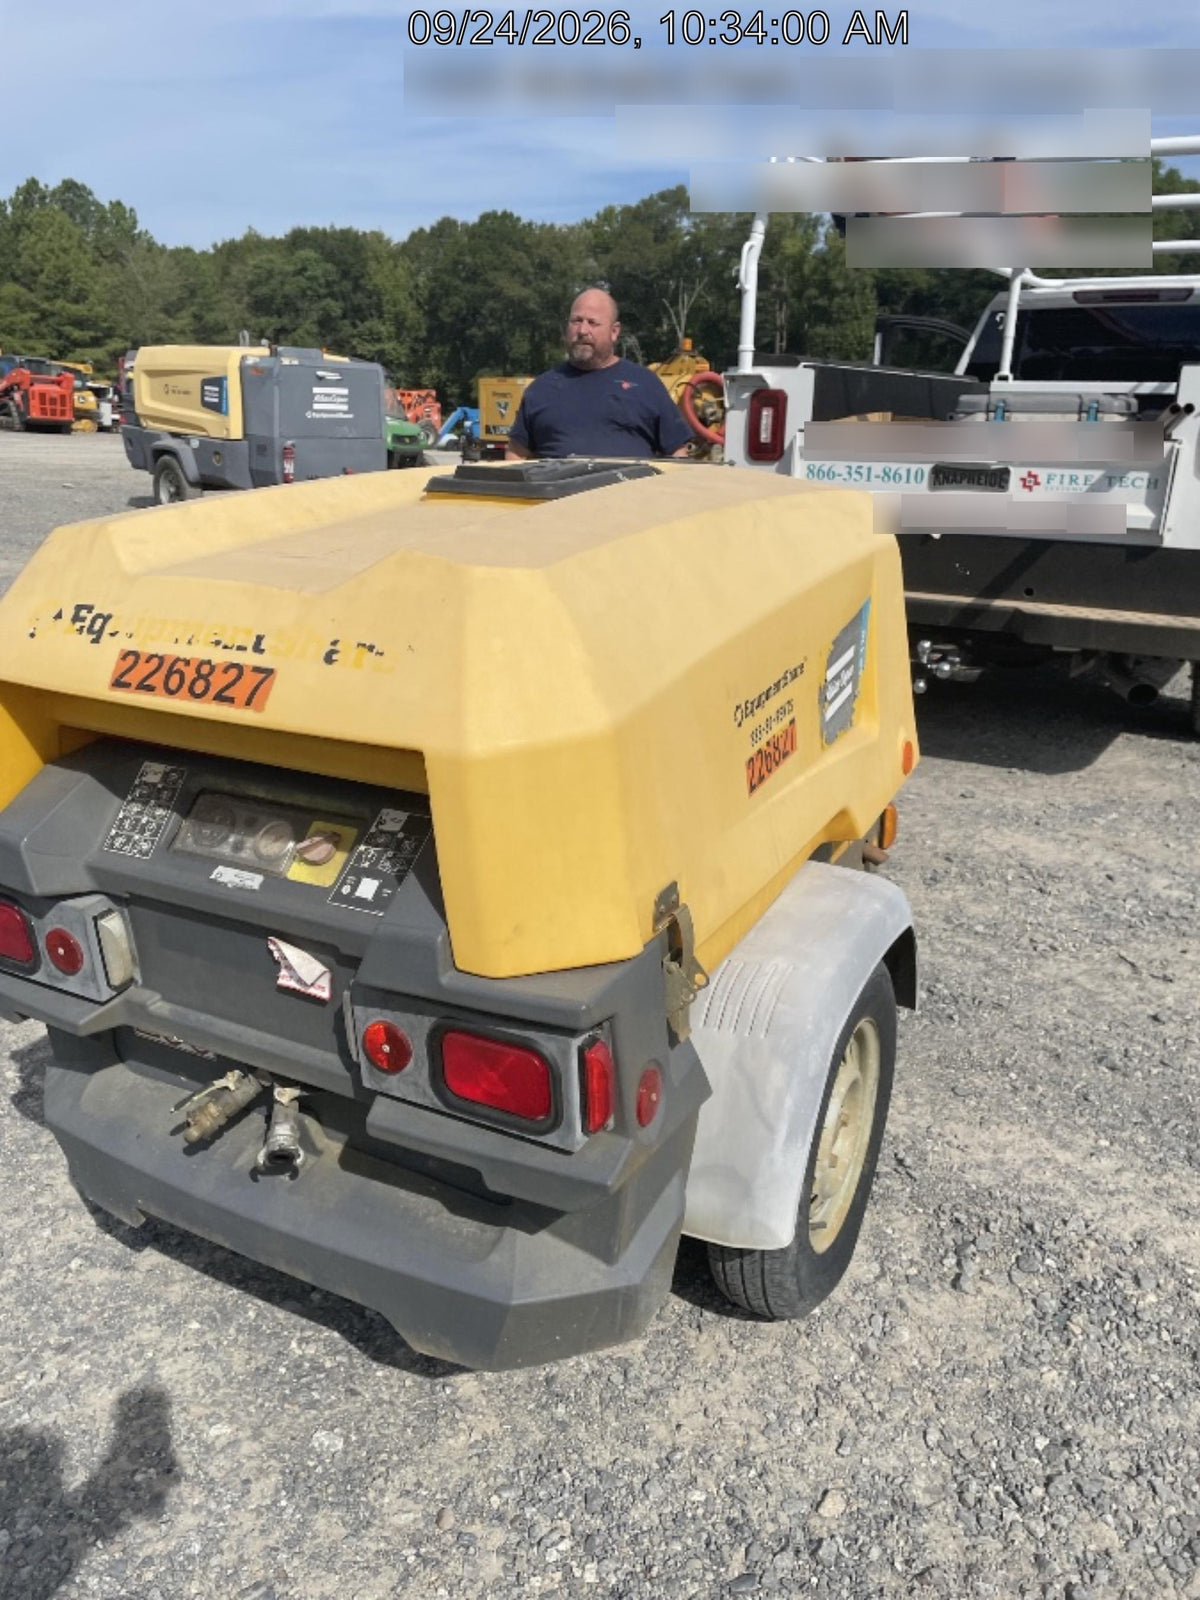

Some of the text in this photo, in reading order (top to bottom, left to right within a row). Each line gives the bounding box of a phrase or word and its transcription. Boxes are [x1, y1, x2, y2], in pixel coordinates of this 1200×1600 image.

[806, 463, 925, 485] 866-351-8610
[1046, 473, 1159, 491] FIRE TECH
[110, 649, 276, 707] 226827
[747, 717, 797, 794] 226827
